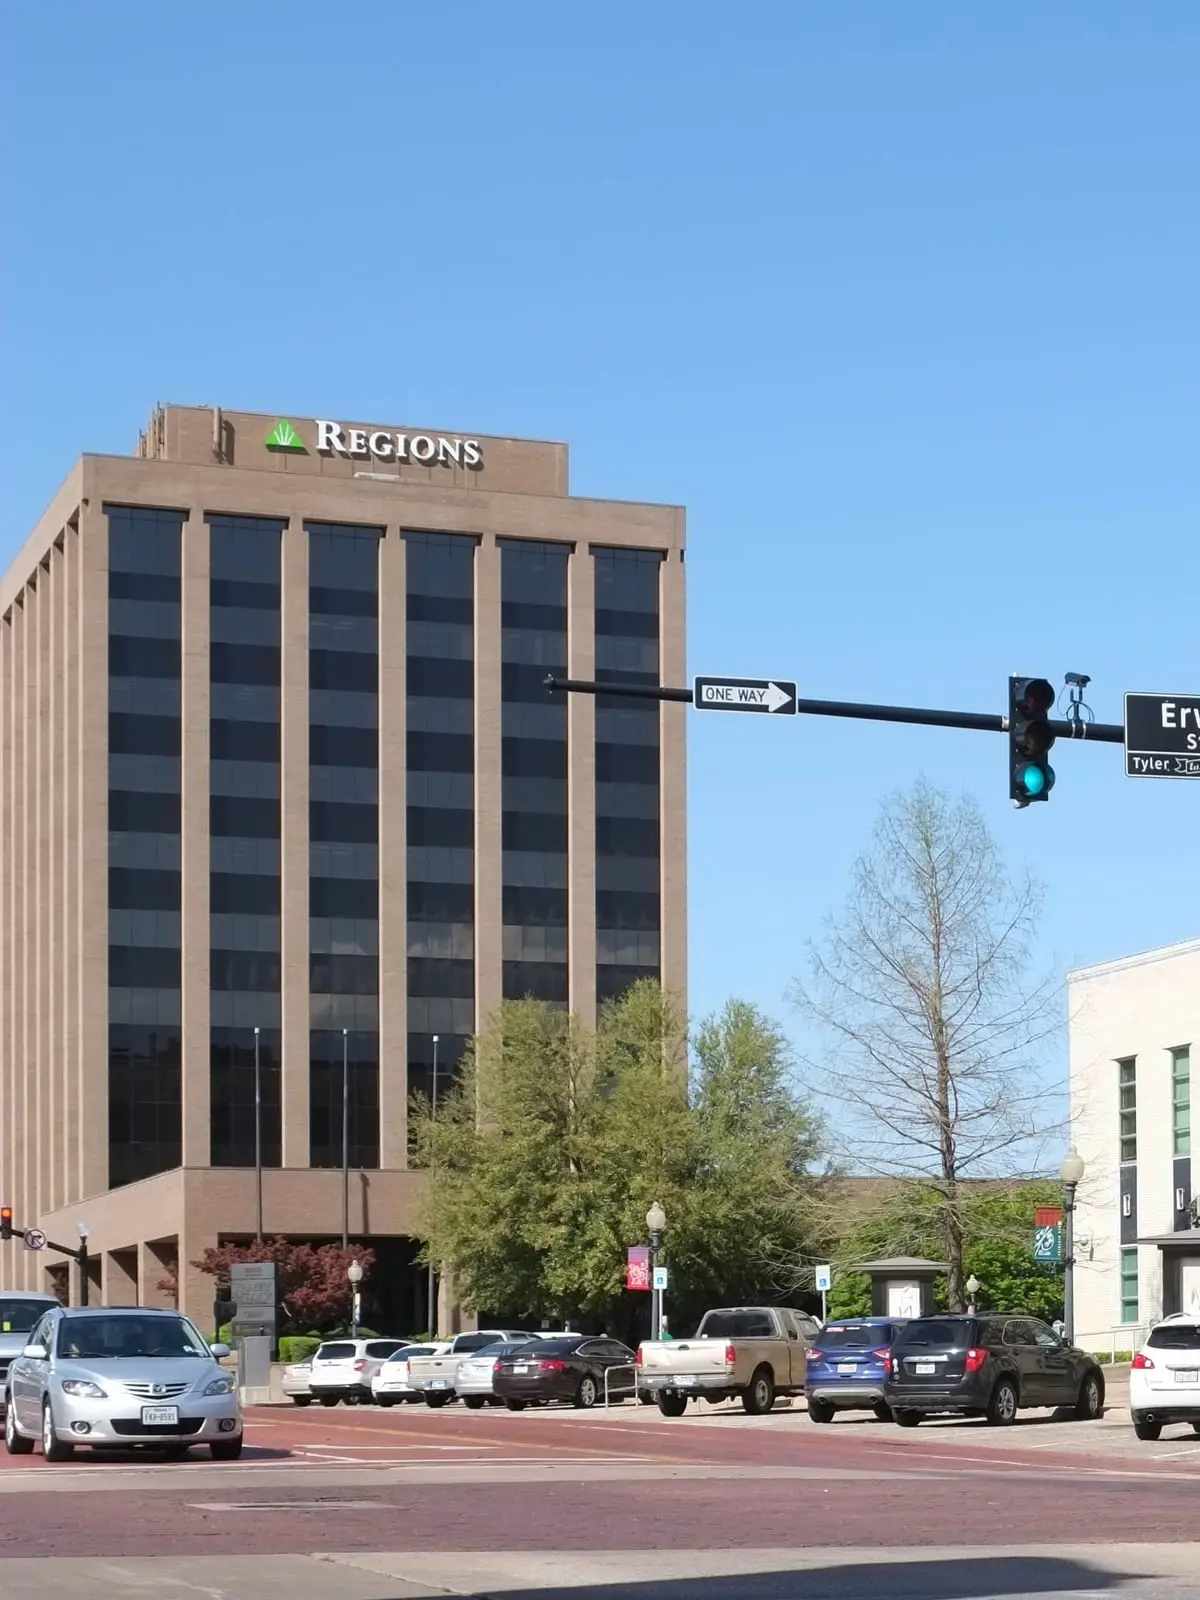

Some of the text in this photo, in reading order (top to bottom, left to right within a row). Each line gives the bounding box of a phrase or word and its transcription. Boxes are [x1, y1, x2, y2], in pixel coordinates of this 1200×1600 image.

[315, 419, 481, 465] REGIONS
[705, 686, 766, 703] ONE WAY
[1133, 756, 1170, 772] Tyler
